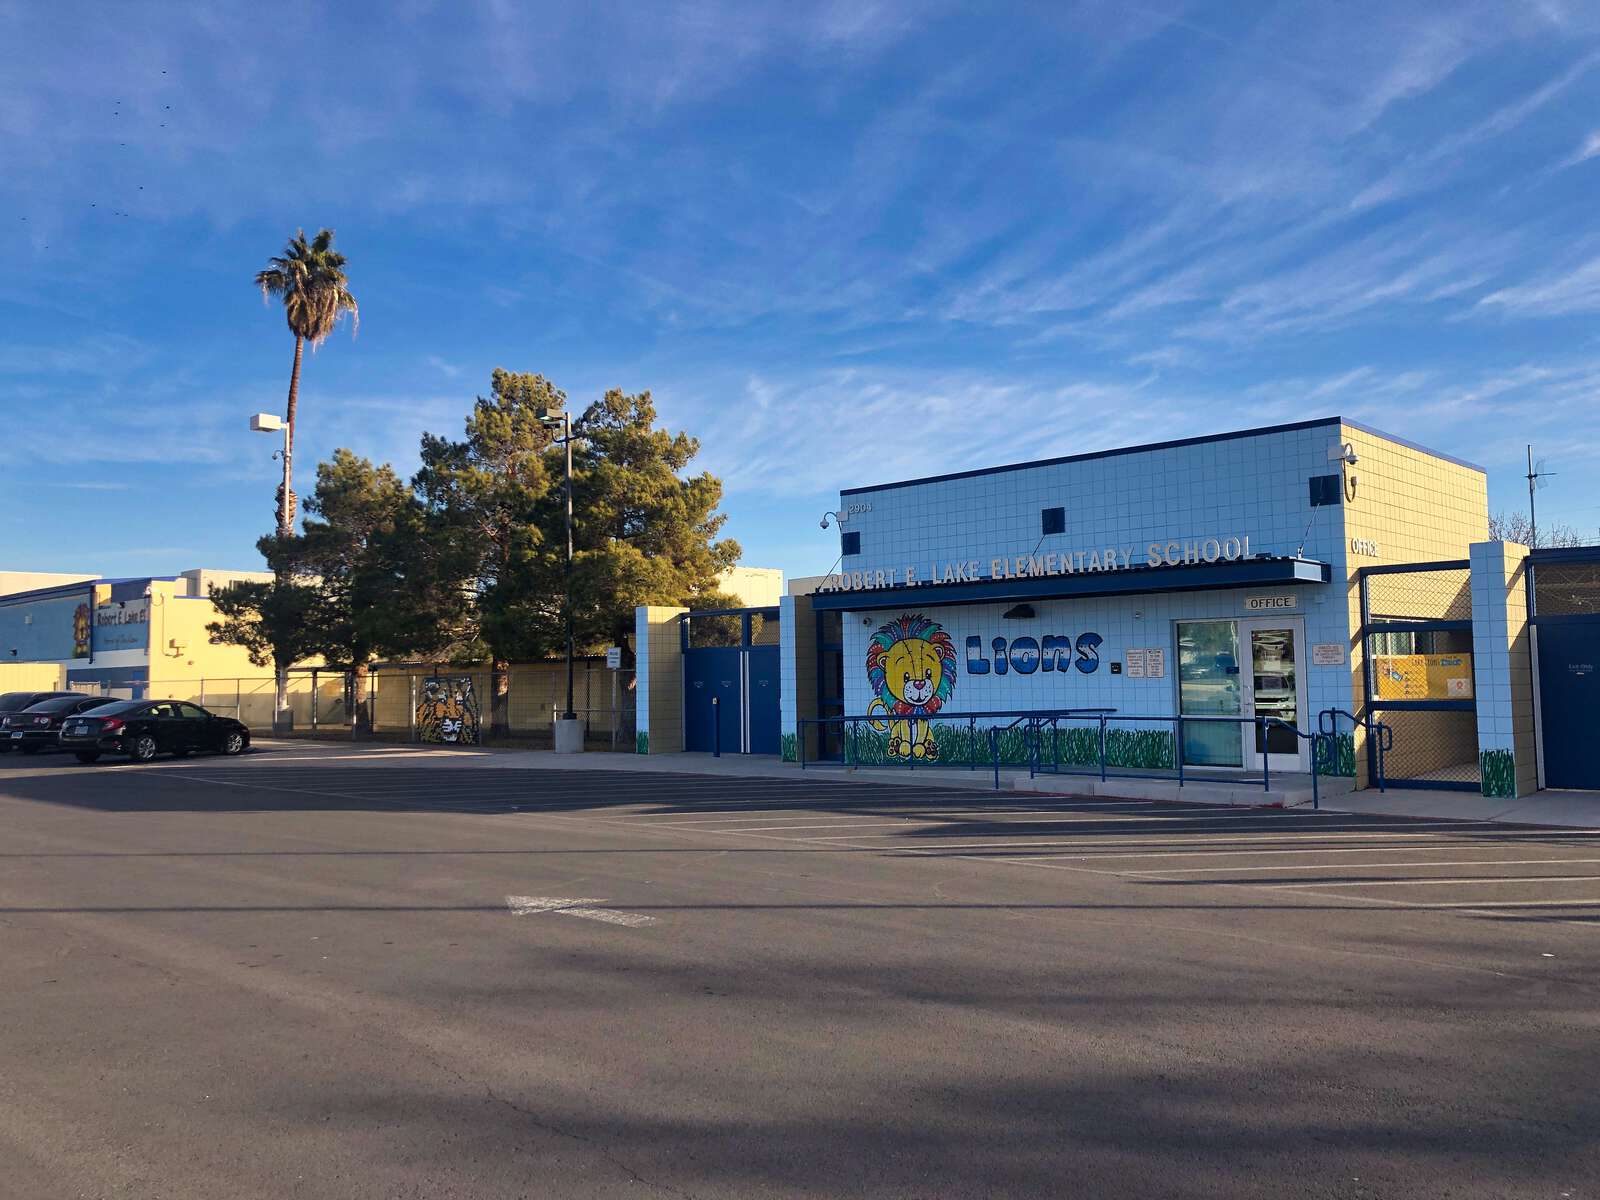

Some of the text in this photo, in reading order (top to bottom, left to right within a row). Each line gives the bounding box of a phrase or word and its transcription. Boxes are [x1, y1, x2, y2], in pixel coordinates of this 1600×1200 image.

[828, 567, 898, 592] ROBERT
[931, 560, 981, 585] LAKE
[991, 545, 1135, 580] ELEMENTARY
[1147, 535, 1257, 568] SCHOOL
[1250, 597, 1293, 608] OFFICE
